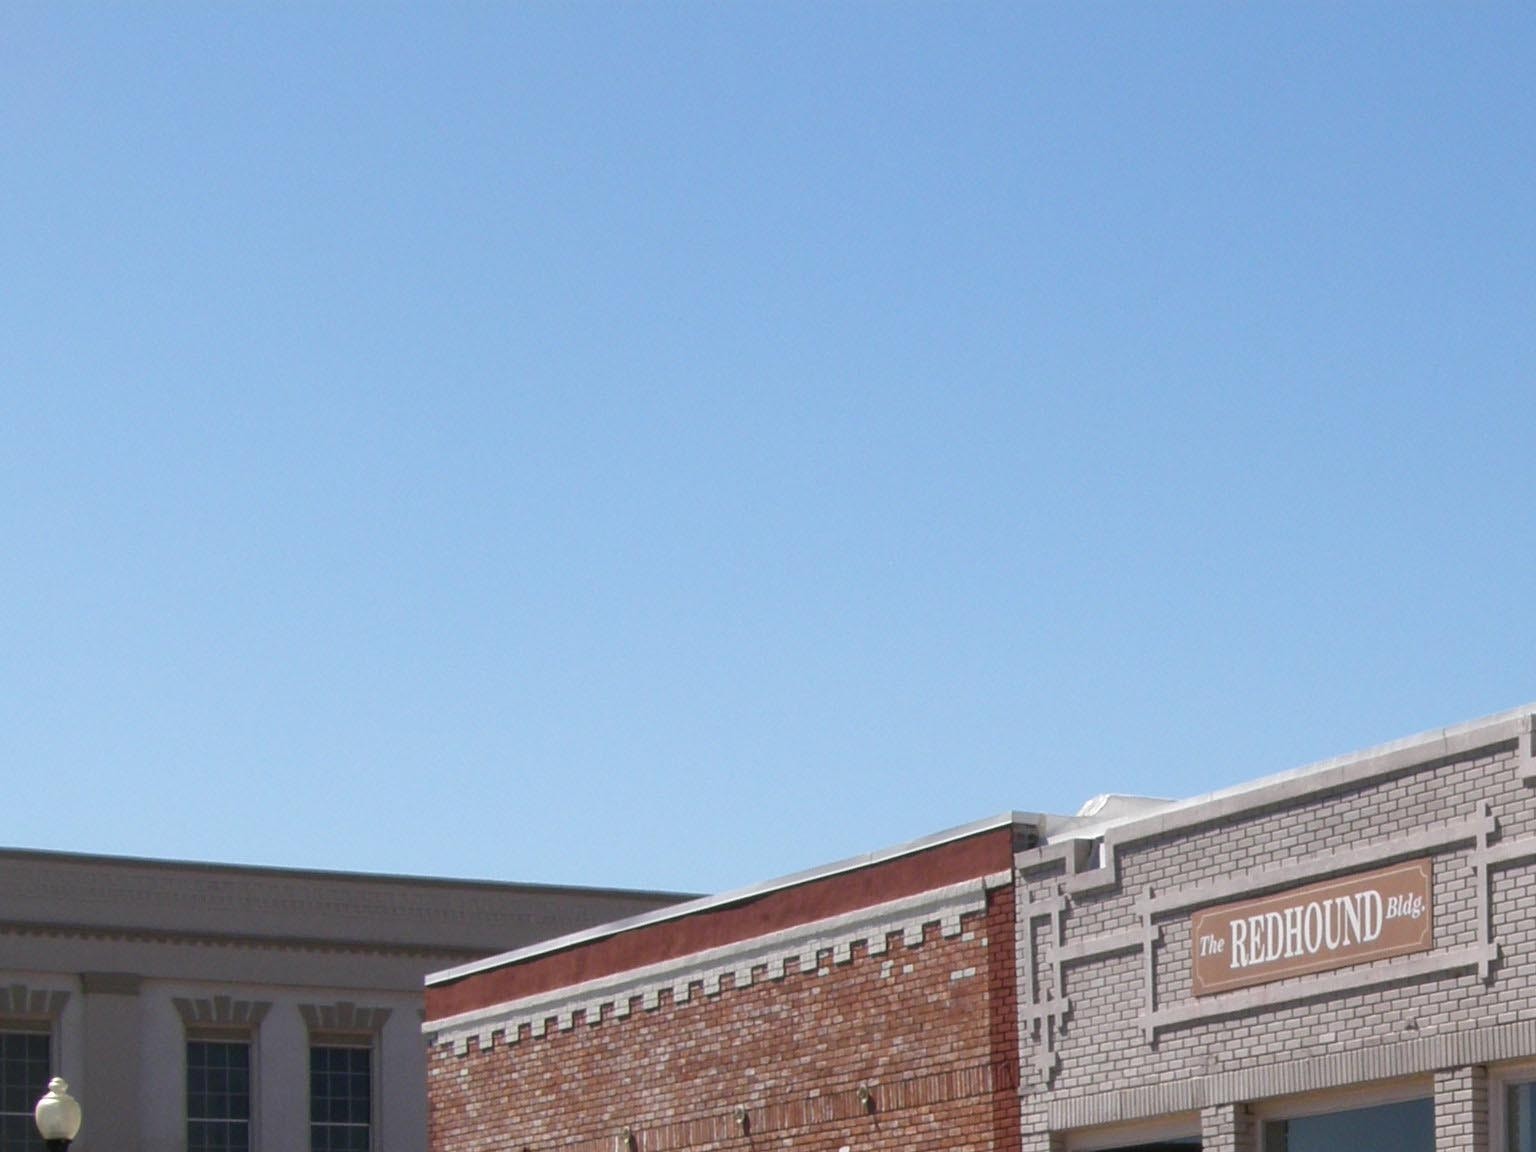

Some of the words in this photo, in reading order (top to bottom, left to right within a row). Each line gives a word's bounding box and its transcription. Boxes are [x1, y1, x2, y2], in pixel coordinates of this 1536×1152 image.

[1199, 934, 1225, 957] The
[1229, 889, 1384, 969] REDHOUND
[1385, 892, 1426, 920] Bldg.
